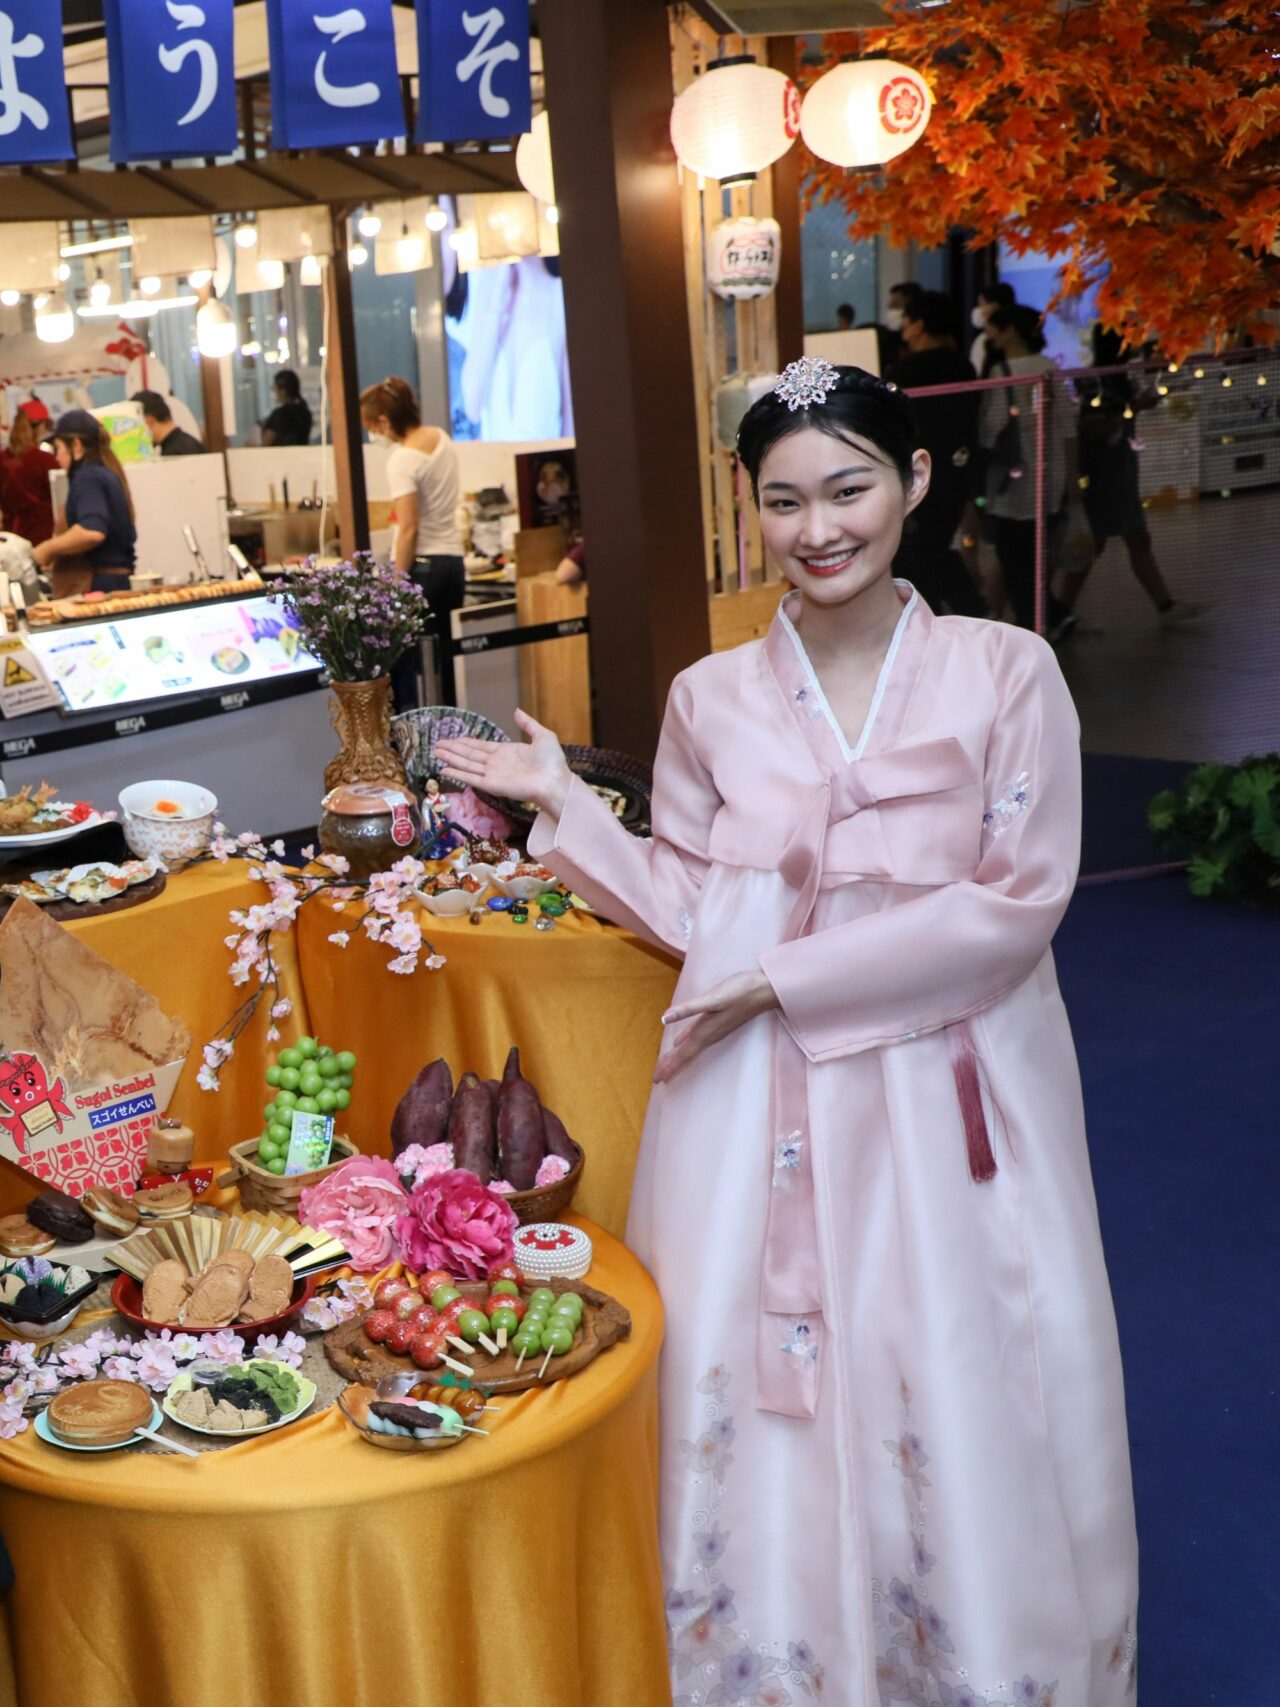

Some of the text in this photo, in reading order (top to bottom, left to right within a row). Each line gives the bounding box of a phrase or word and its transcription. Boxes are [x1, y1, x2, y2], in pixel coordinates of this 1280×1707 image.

[221, 690, 250, 707] MEGA
[115, 716, 146, 732] MEGA
[3, 737, 36, 755] MEGA
[74, 1072, 156, 1109] Sugoi Senbei
